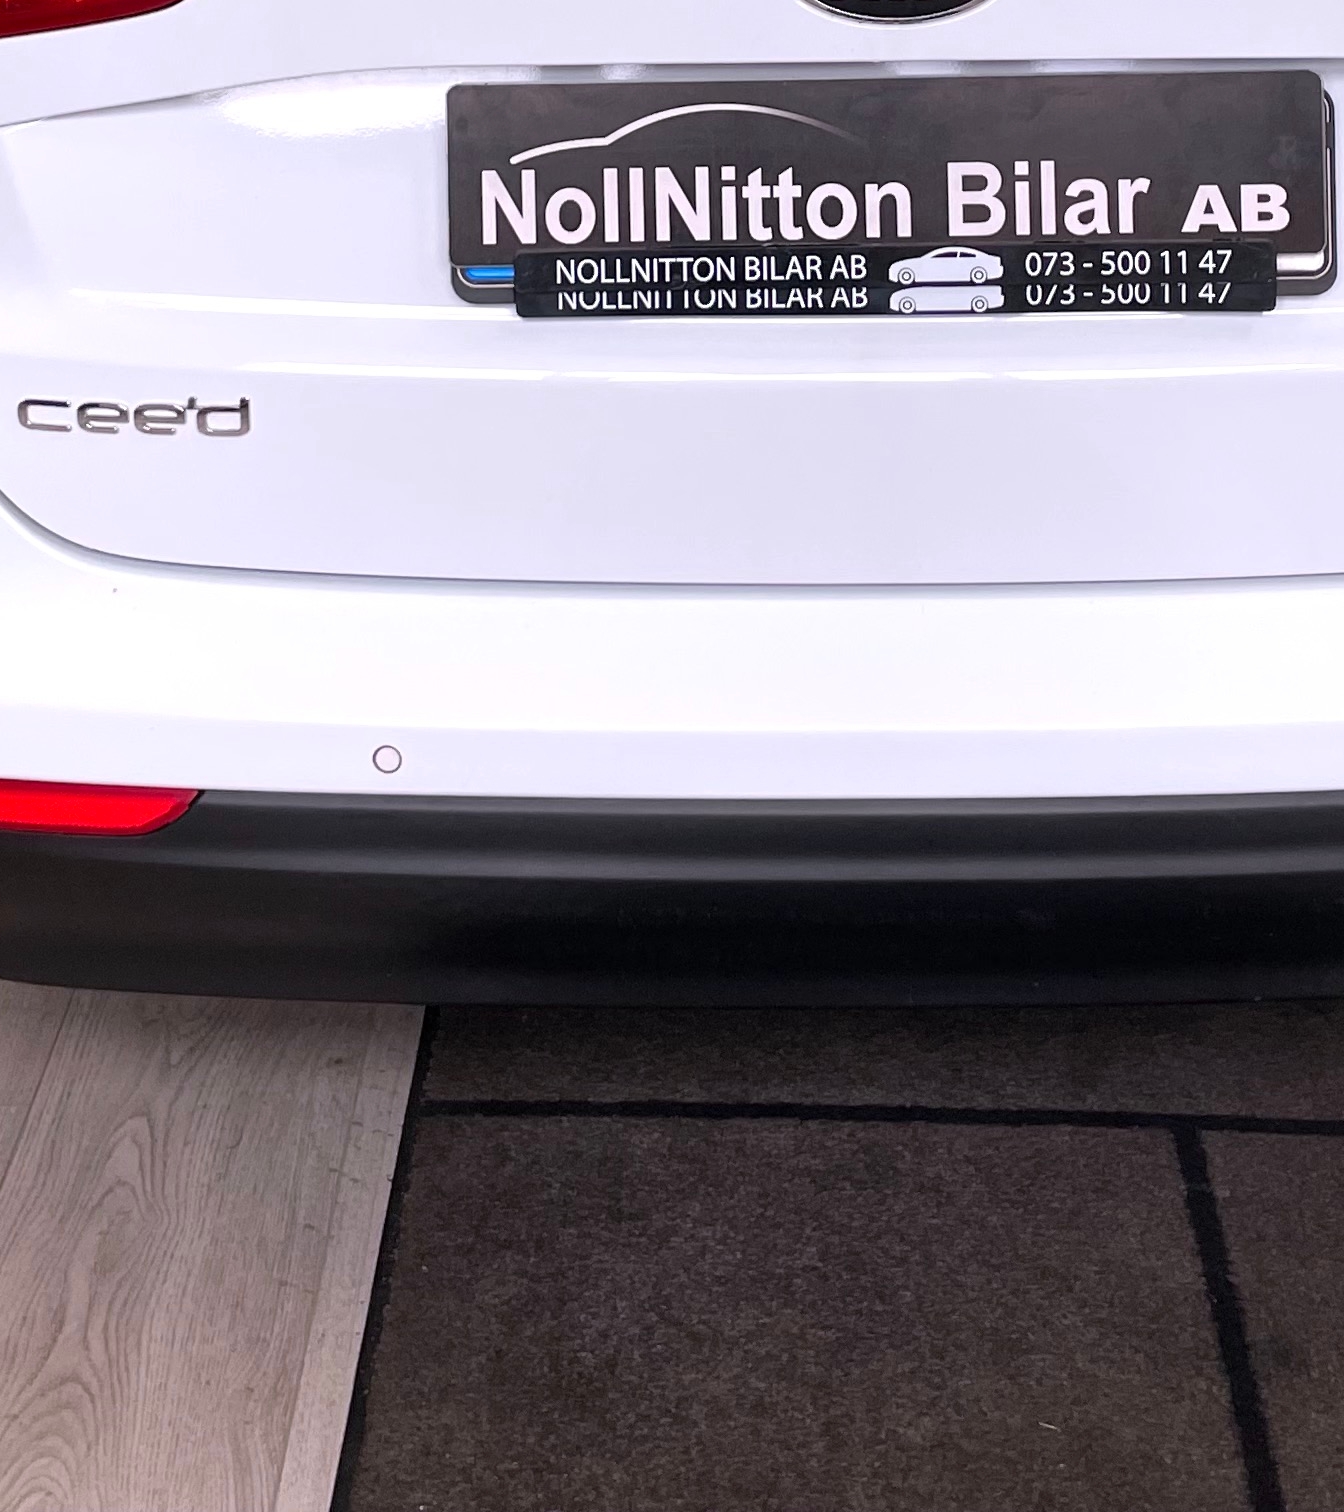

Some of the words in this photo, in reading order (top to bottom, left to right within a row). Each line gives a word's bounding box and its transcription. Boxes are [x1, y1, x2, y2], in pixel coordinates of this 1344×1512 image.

[481, 165, 913, 245] NollNitton
[946, 159, 1152, 237] Bilar
[1181, 183, 1291, 234] AB
[556, 256, 736, 285] NOLLNITTON
[744, 254, 823, 282] BILAR
[829, 254, 868, 280] AB
[1024, 251, 1076, 277] 073
[1100, 250, 1151, 276] 500
[1160, 250, 1188, 275] 11
[1198, 249, 1233, 274] 47
